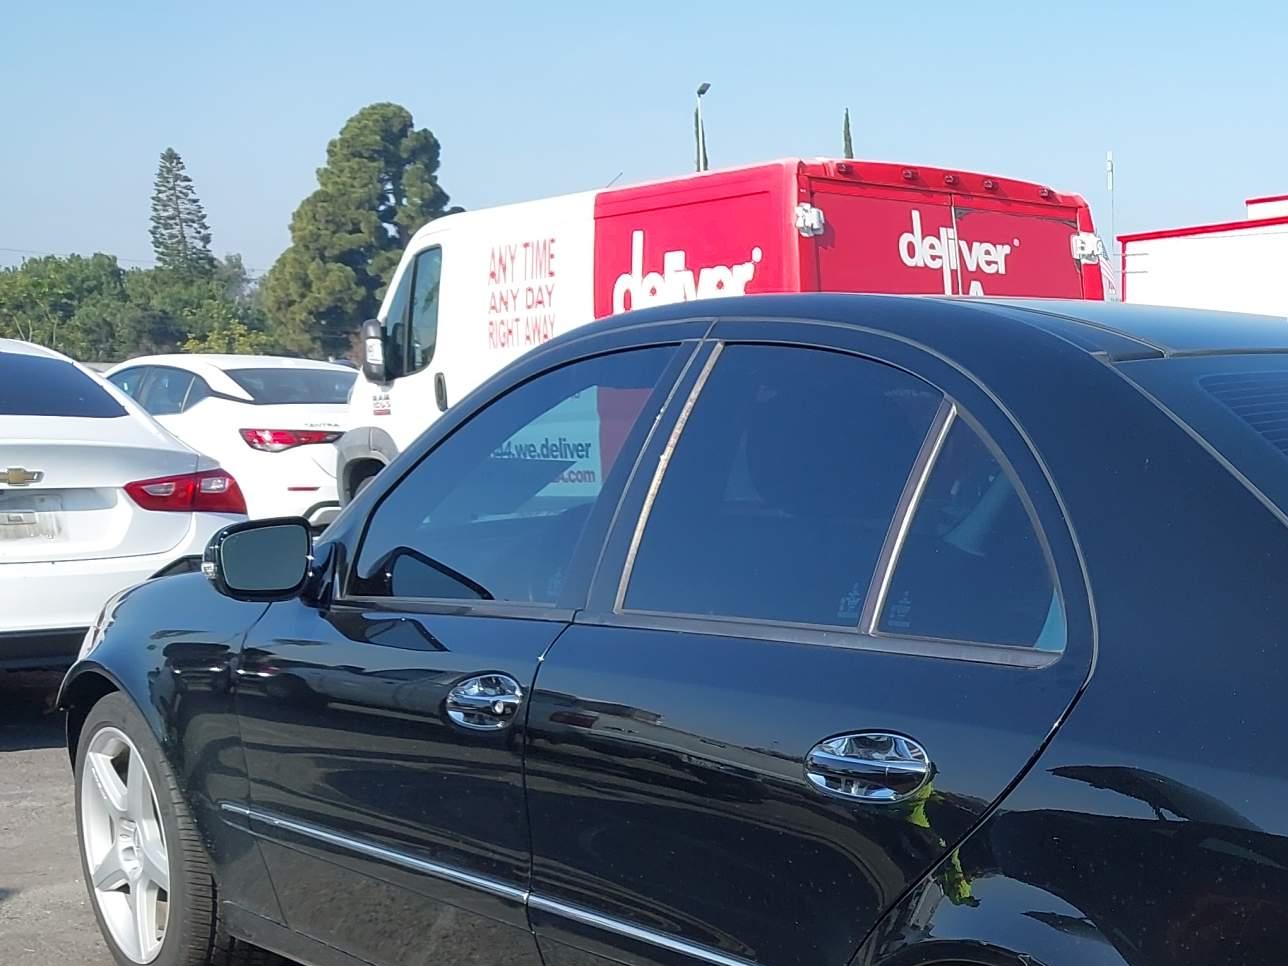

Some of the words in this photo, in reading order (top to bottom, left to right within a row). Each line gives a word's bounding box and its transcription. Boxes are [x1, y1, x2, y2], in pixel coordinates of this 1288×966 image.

[487, 244, 519, 286] ANY
[522, 238, 556, 281] TIME
[898, 209, 1011, 274] deliver
[487, 288, 520, 314] ANY
[525, 283, 556, 310] DAY
[488, 318, 521, 350] RIGHT
[524, 313, 556, 346] AWAY
